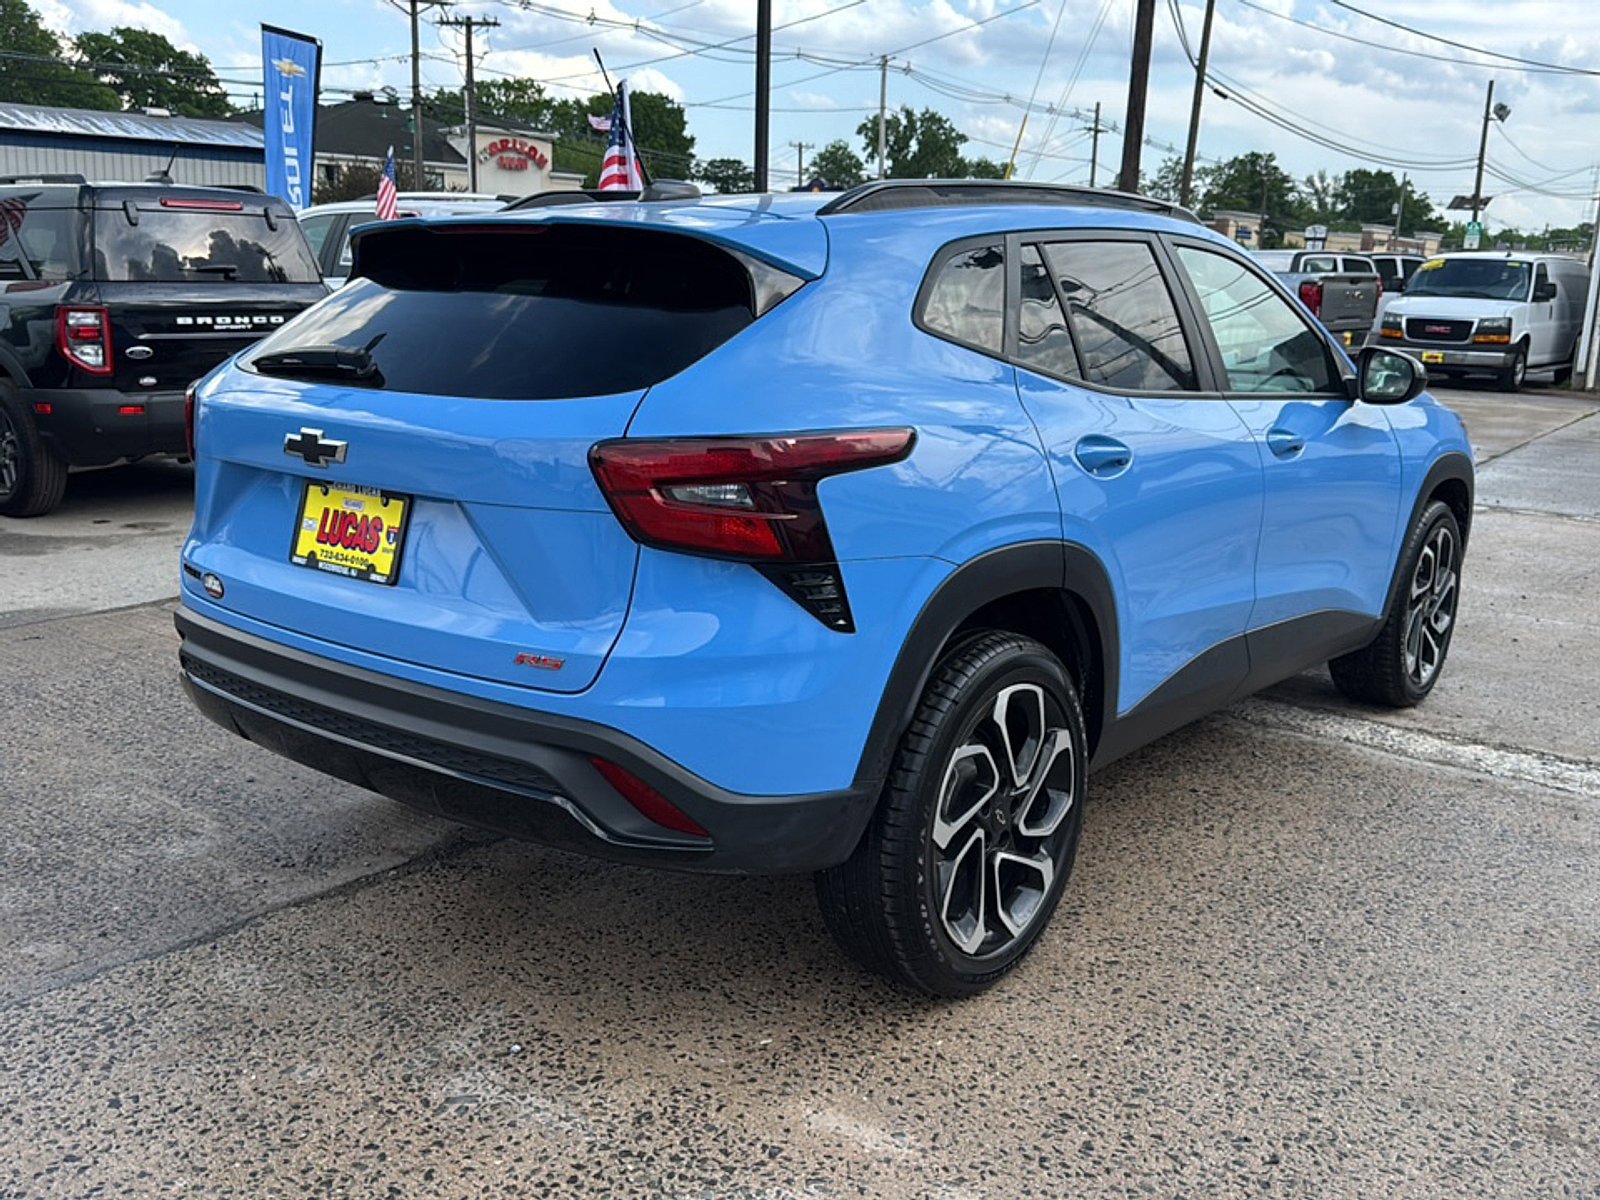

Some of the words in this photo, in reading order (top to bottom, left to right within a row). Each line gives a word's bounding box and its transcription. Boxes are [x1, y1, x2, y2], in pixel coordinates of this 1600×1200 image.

[176, 316, 285, 325] BRONCO
[317, 507, 383, 554] LUCAS
[515, 653, 564, 670] RS
